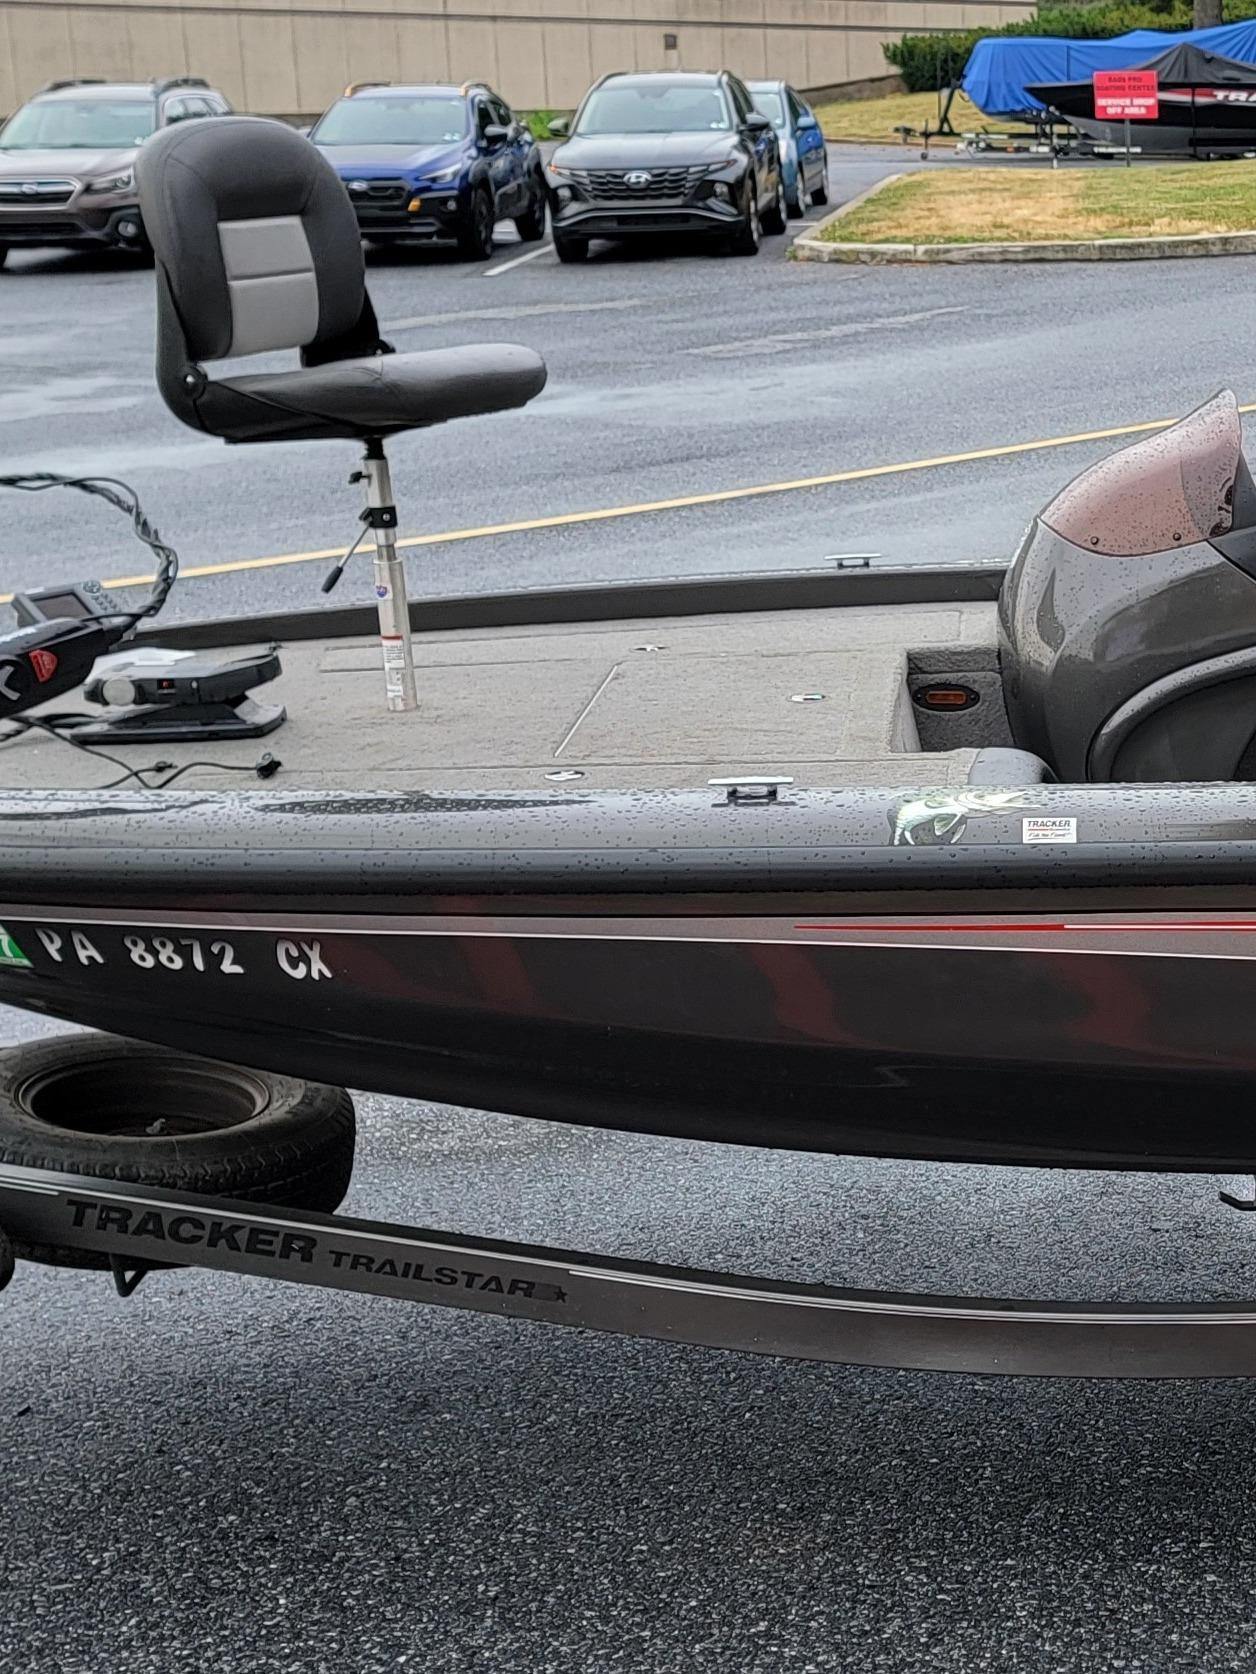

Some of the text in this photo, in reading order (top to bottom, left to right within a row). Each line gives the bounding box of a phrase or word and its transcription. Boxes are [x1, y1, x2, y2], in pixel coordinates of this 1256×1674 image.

[1027, 820, 1071, 828] TRACKER
[35, 927, 333, 981] PA 8872 CX
[66, 1200, 537, 1299] TRACKER TRAILSTAR
